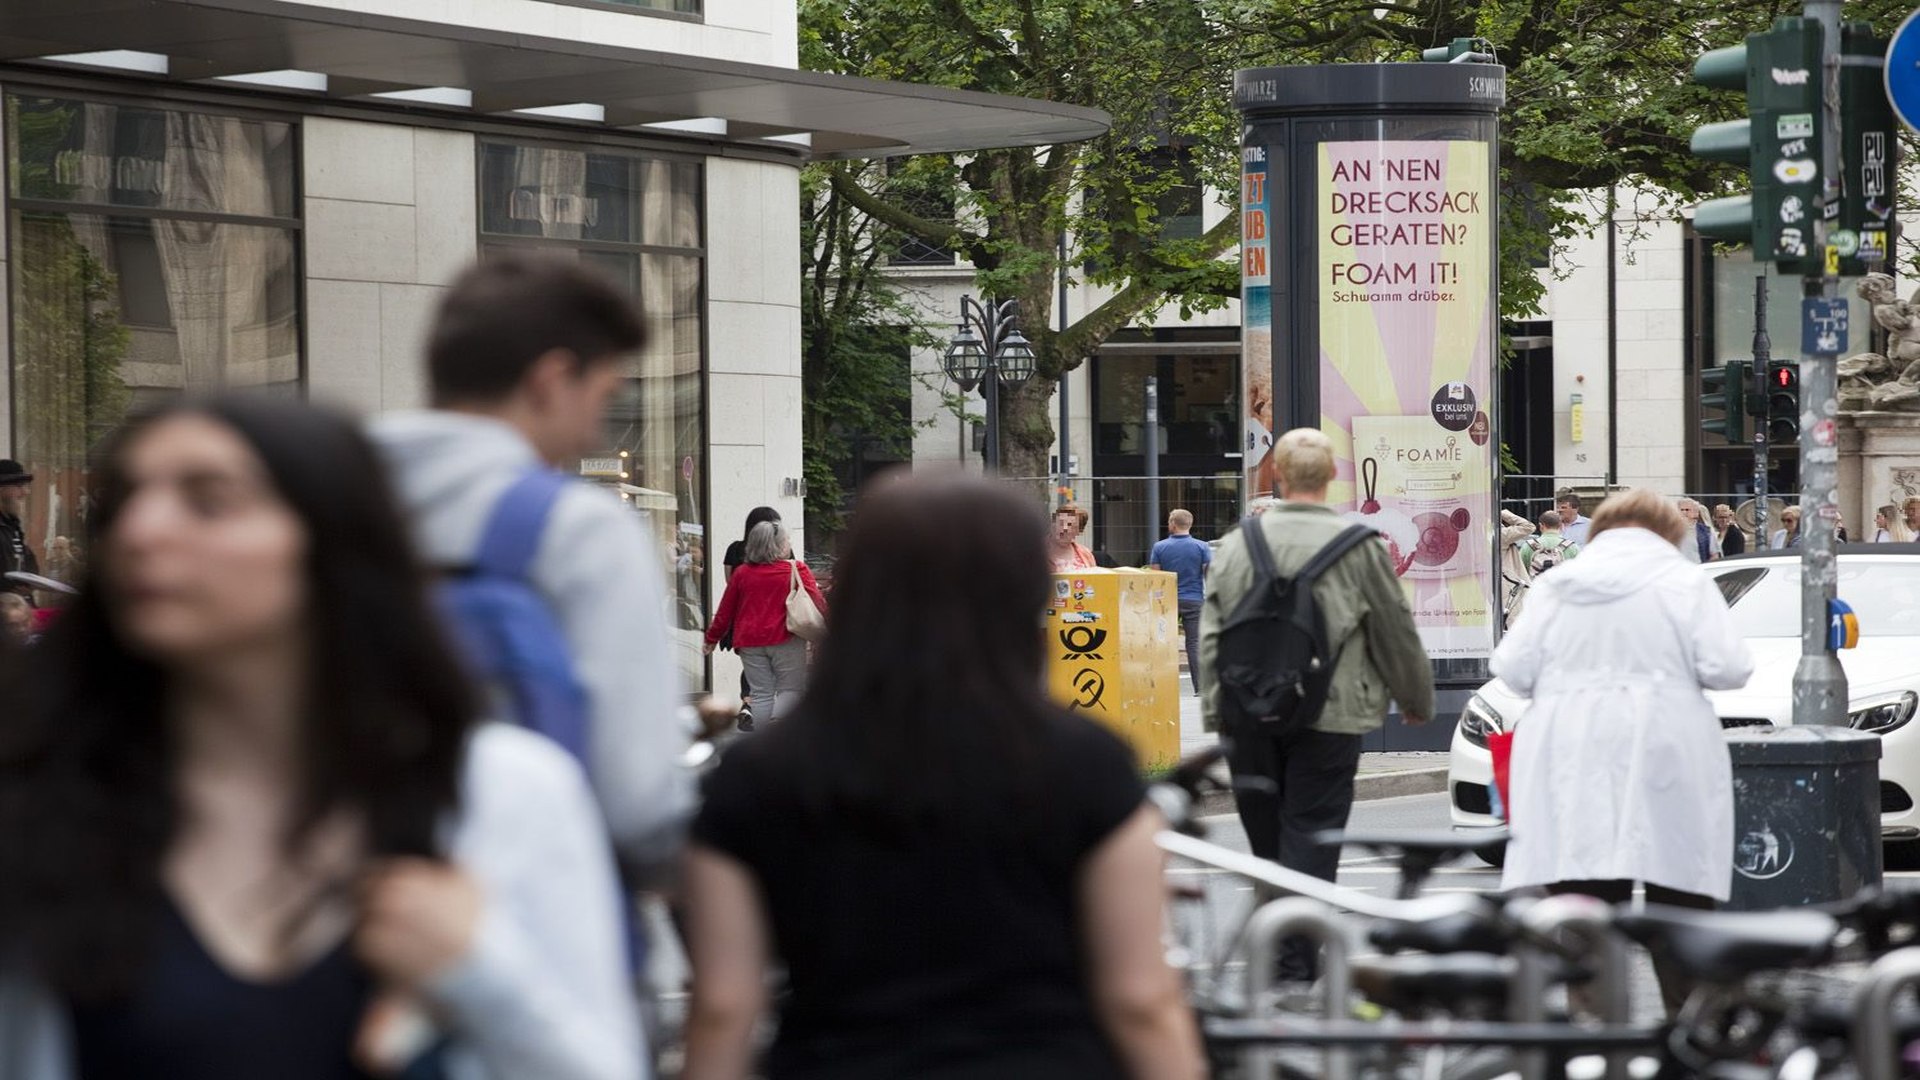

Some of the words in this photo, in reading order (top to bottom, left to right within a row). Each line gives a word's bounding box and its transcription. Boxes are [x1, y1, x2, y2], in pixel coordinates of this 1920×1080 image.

[1865, 134, 1883, 160] PU
[1331, 160, 1371, 182] AN
[1381, 159, 1440, 181] 'NEN
[1864, 167, 1882, 192] PU
[1243, 172, 1266, 204] ZT
[1331, 191, 1480, 214] DRECKSACK
[1330, 223, 1467, 246] GERATEN?
[1332, 262, 1416, 285] FOAM
[1430, 262, 1457, 284] IT!
[1332, 291, 1402, 303] Schwamm
[1408, 290, 1455, 302] drüber.
[1435, 403, 1474, 412] EXKLUSIV
[1397, 446, 1462, 461] FOAMIE
